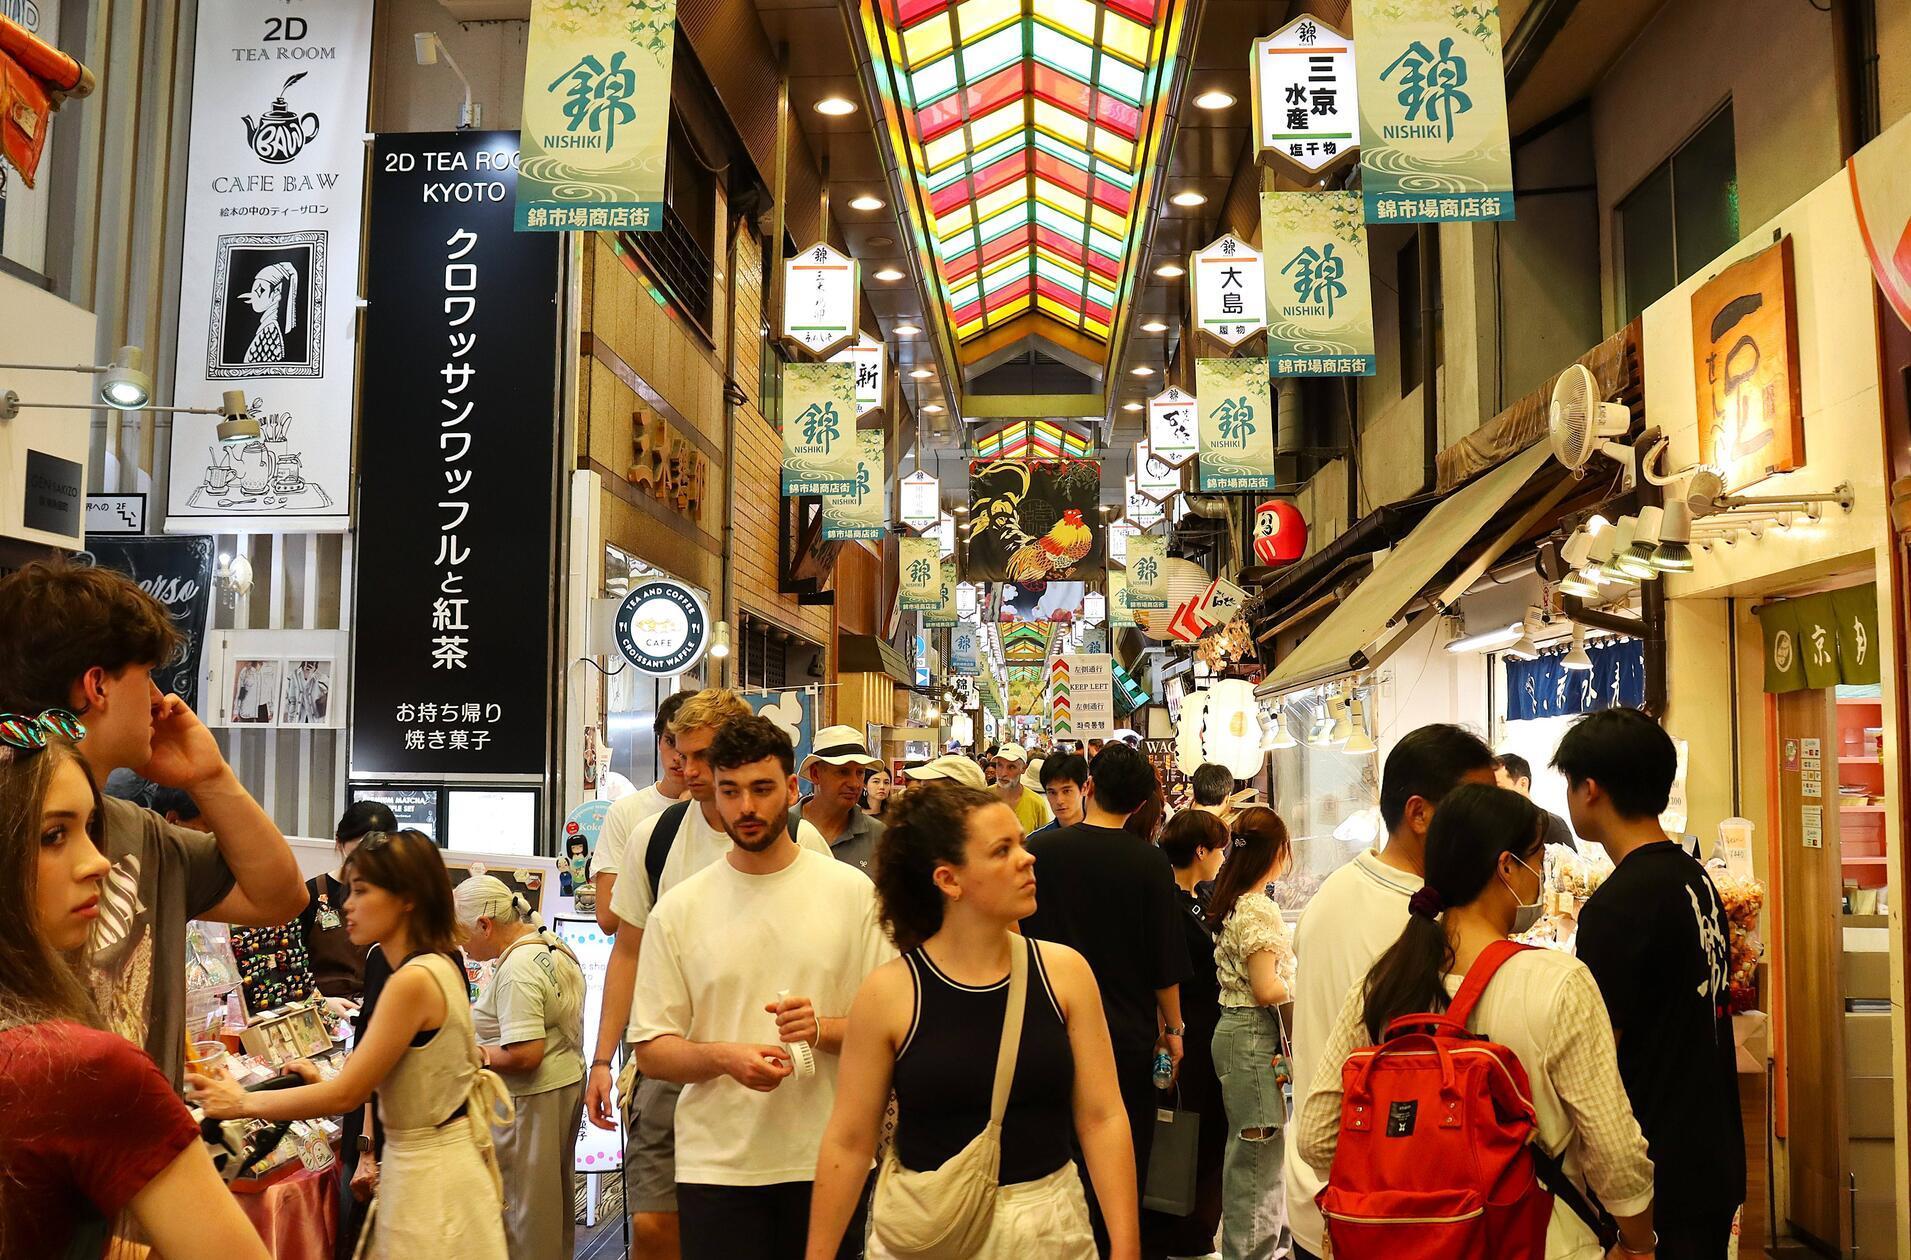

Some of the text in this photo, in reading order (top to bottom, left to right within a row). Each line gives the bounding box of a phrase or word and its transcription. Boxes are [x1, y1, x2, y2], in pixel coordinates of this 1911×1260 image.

[263, 17, 308, 41] 2D
[232, 47, 336, 61] TEA ROOM
[1379, 37, 1473, 143] 錦
[547, 51, 637, 154] 錦
[256, 123, 303, 158] BAW
[544, 135, 602, 149] NISHIKI
[1383, 125, 1441, 139] NISHIKI
[1290, 142, 1337, 157] 塩干物
[385, 150, 519, 172] 2D TEA ROO
[212, 173, 339, 193] CAFE BAW
[423, 182, 506, 203] KYOTO
[220, 205, 329, 217] 絵本の中のティーサロン
[527, 207, 650, 227] 錦市場商店街
[1377, 197, 1501, 218] 錦市場商店街
[1221, 266, 1243, 315] 大島
[1281, 243, 1347, 319] 錦
[1283, 306, 1325, 316] NISHIKI
[1279, 359, 1366, 374] 錦市場商店街
[795, 401, 840, 454] 錦
[1210, 396, 1257, 449] 錦
[432, 228, 478, 669] クロワッサンワッフルと紅茶
[1211, 440, 1240, 448] NISHIKI
[789, 483, 850, 493] 錦市場商店街
[1207, 477, 1269, 488] 錦市場商店街
[828, 529, 879, 538] 錦市場商店街
[906, 559, 931, 587] 錦
[1133, 556, 1158, 587] 錦
[626, 588, 695, 615] TEA AND COFFEE
[622, 639, 695, 668] CROISSANT WAFFLE
[646, 639, 672, 647] CAFE
[396, 703, 501, 723] お持ち帰り
[405, 730, 491, 751] 焼き菓子
